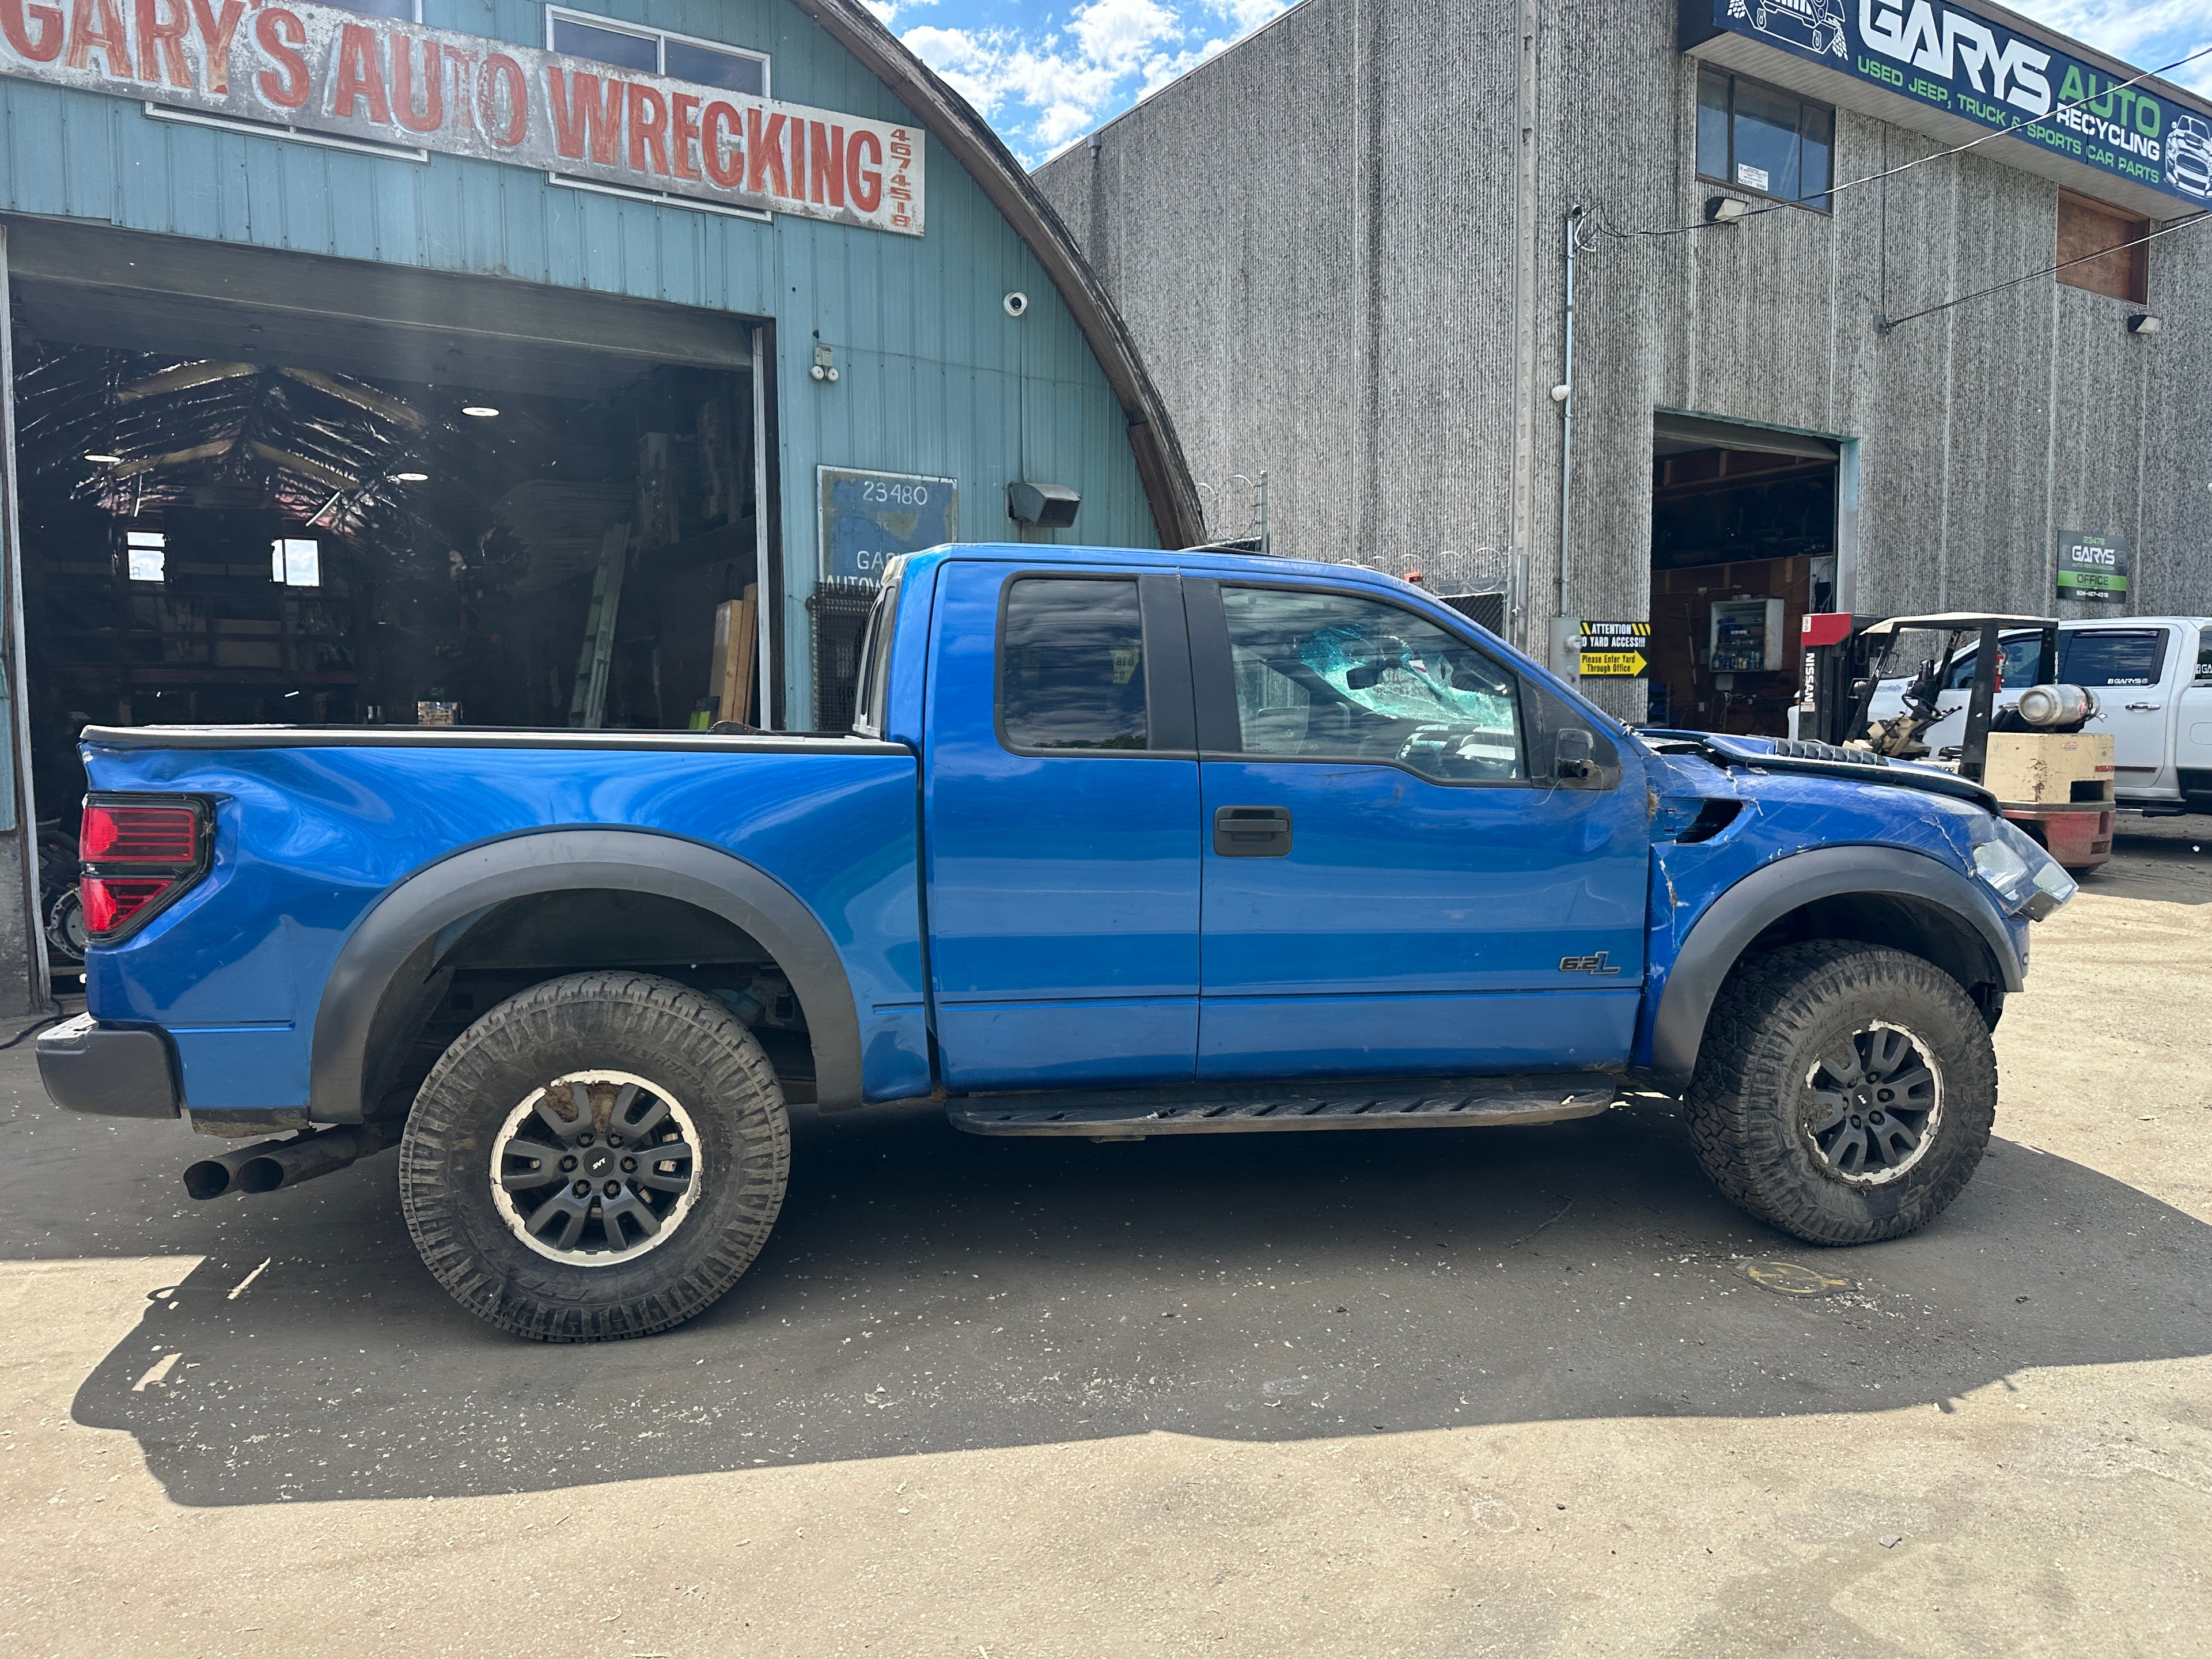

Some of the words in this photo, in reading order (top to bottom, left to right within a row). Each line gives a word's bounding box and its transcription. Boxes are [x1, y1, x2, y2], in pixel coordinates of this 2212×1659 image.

[1859, 0, 2051, 116] GARYS
[2058, 65, 2160, 138] AUTO
[334, 23, 527, 147] AUTO
[547, 65, 883, 214] WRECKING
[1858, 55, 1903, 87] USED
[1908, 77, 1952, 109] JEEP,
[1957, 93, 2006, 127] TRUCK
[2011, 115, 2022, 132] &
[2027, 123, 2082, 155] SPORTS
[2086, 145, 2115, 167] CAR
[2118, 157, 2159, 184] PARTS
[2056, 102, 2160, 161] RECYCLING
[863, 480, 928, 506] 23480
[2071, 545, 2115, 565] GARYS
[2077, 574, 2109, 586] OFFICE
[1592, 623, 1631, 635] ATTENTION
[1590, 637, 1609, 647] YARD
[1611, 637, 1646, 647] ACCESS!!!
[1582, 655, 1601, 663] Please
[1604, 655, 1620, 663] Enter
[1623, 655, 1635, 663] Yard
[1587, 664, 1611, 673] Through
[1613, 664, 1631, 672] Office
[1804, 653, 1815, 702] NISSAN
[1559, 951, 1621, 975] 6.2L
[592, 1157, 606, 1170] SVT
